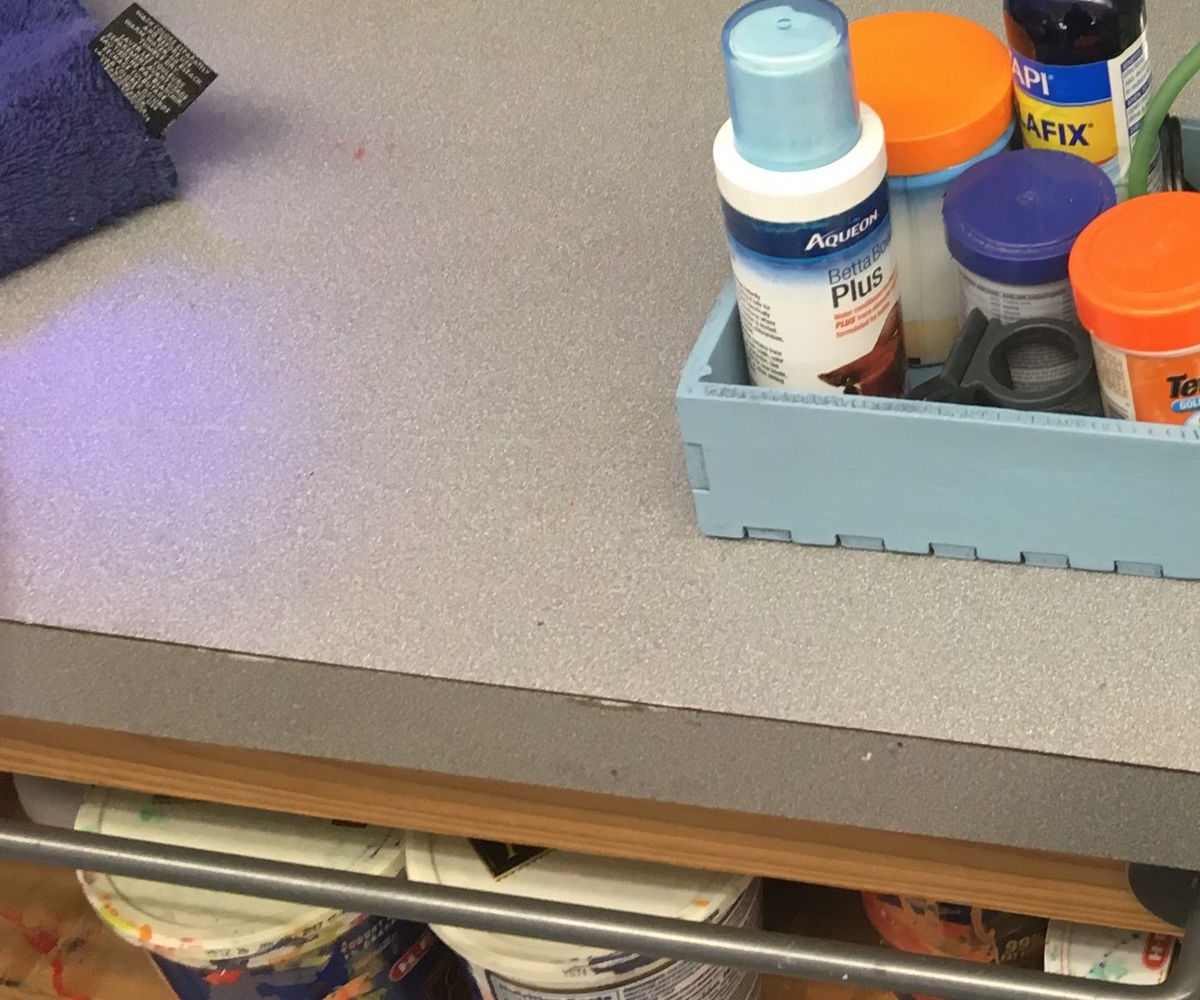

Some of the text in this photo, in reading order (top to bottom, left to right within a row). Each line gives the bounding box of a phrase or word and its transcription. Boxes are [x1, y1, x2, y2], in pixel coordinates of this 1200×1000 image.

[1012, 57, 1050, 96] API
[1023, 113, 1089, 146] AFIX
[805, 209, 878, 251] AQUEON
[828, 255, 871, 285] Betta
[831, 266, 883, 308] Plus
